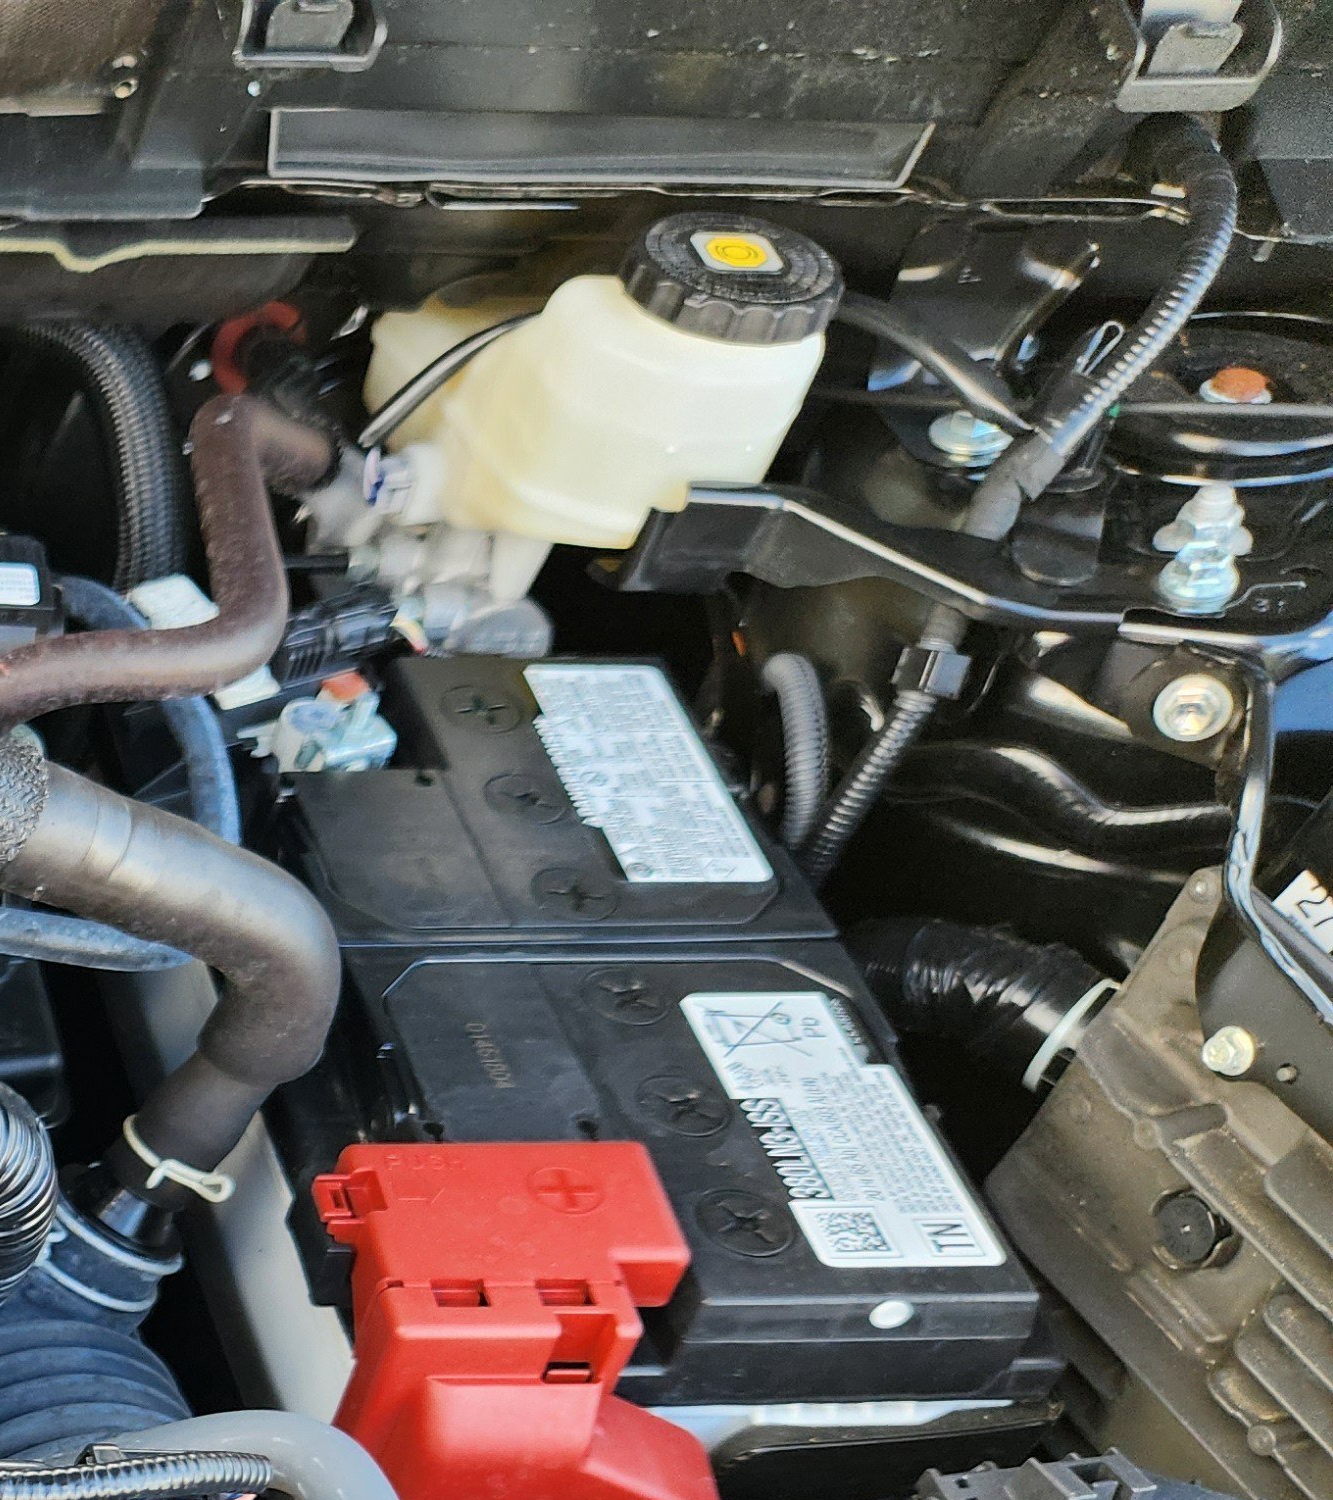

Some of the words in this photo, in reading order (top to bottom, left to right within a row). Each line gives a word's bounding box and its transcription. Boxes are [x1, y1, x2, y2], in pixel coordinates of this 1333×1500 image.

[799, 1017, 826, 1038] Pb
[740, 1098, 835, 1200] 380LN3-ISS
[383, 1154, 467, 1171] PUSH
[921, 1223, 975, 1253] TN
